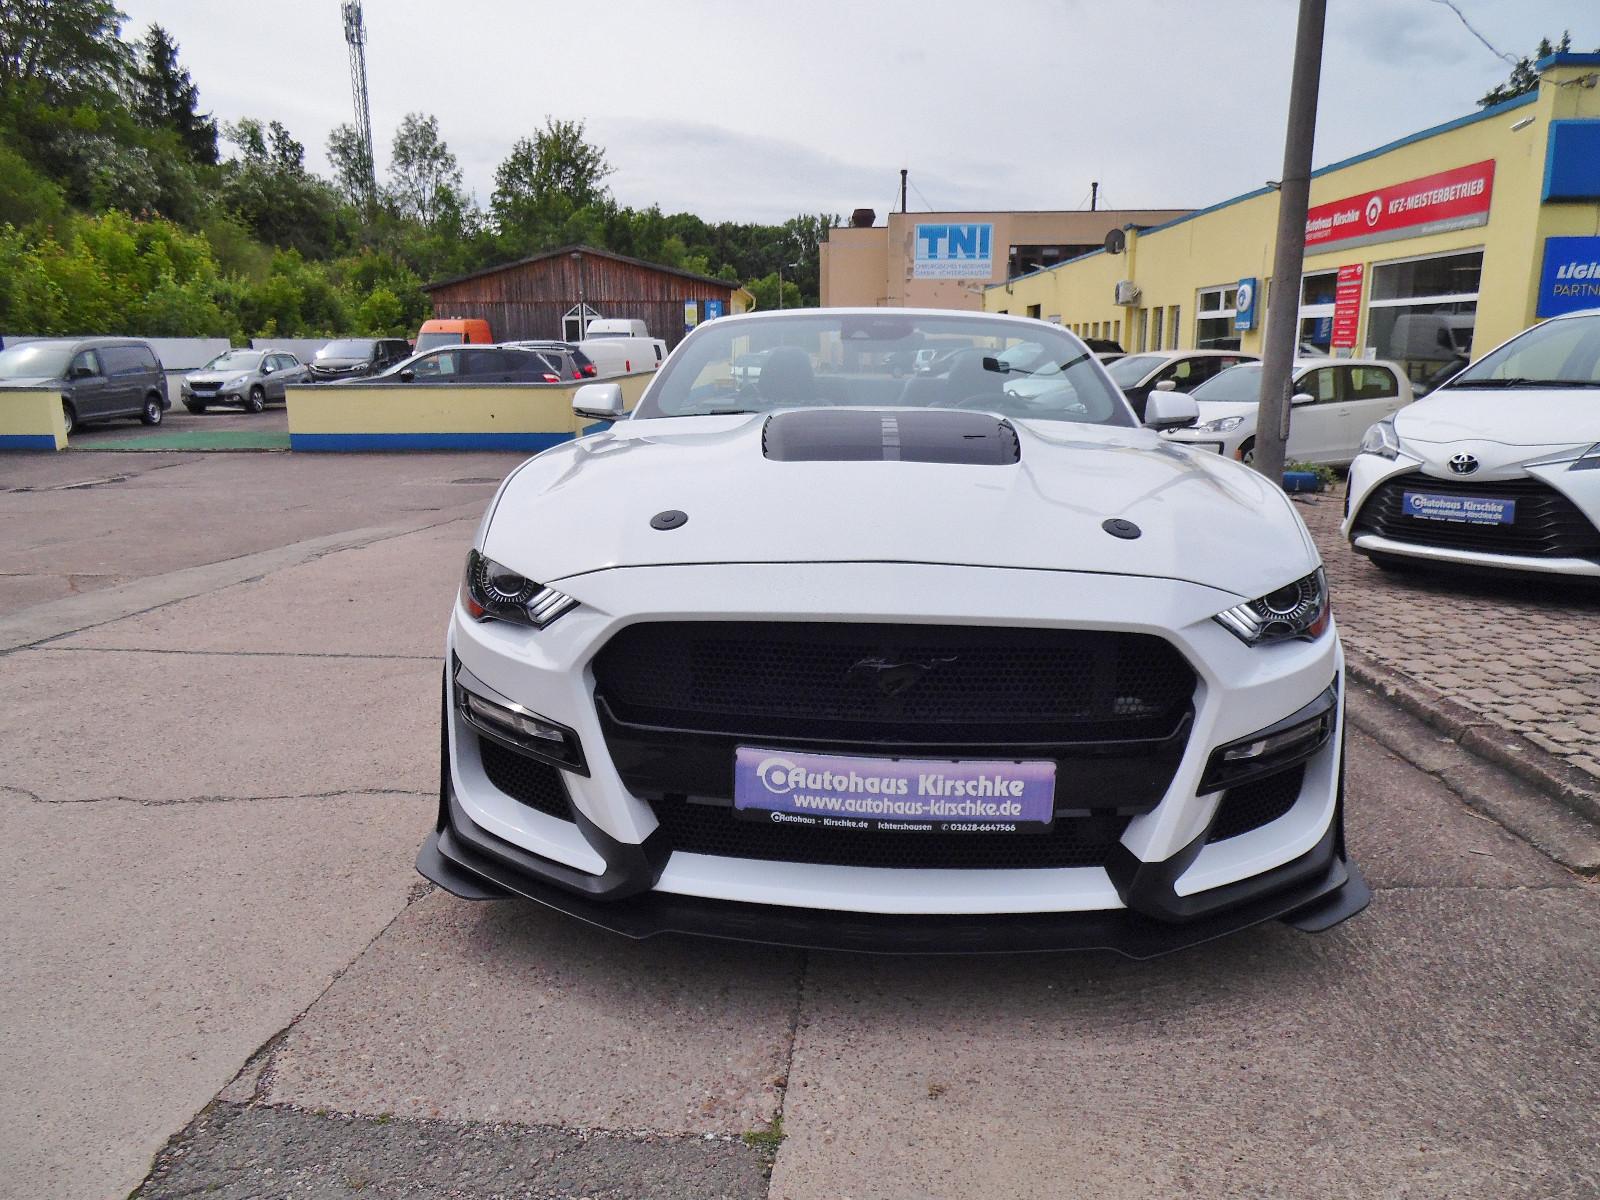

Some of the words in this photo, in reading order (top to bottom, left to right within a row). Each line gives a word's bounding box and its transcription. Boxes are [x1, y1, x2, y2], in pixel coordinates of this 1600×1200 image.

[1388, 179, 1485, 214] KFZ-MEISTERBETRIEB
[919, 225, 990, 259] TNI
[1421, 499, 1460, 509] Autohaus
[1463, 501, 1504, 513] Kirschke
[788, 768, 908, 795] Autohaus
[918, 774, 1025, 797] Kirschke
[793, 794, 1022, 816] www.autohaus-kirschke.de
[779, 814, 816, 825] Autohaus
[823, 818, 868, 829] Kirschke.de
[878, 821, 932, 831] Ichtershausen
[950, 823, 1016, 832] 03628-6647566
